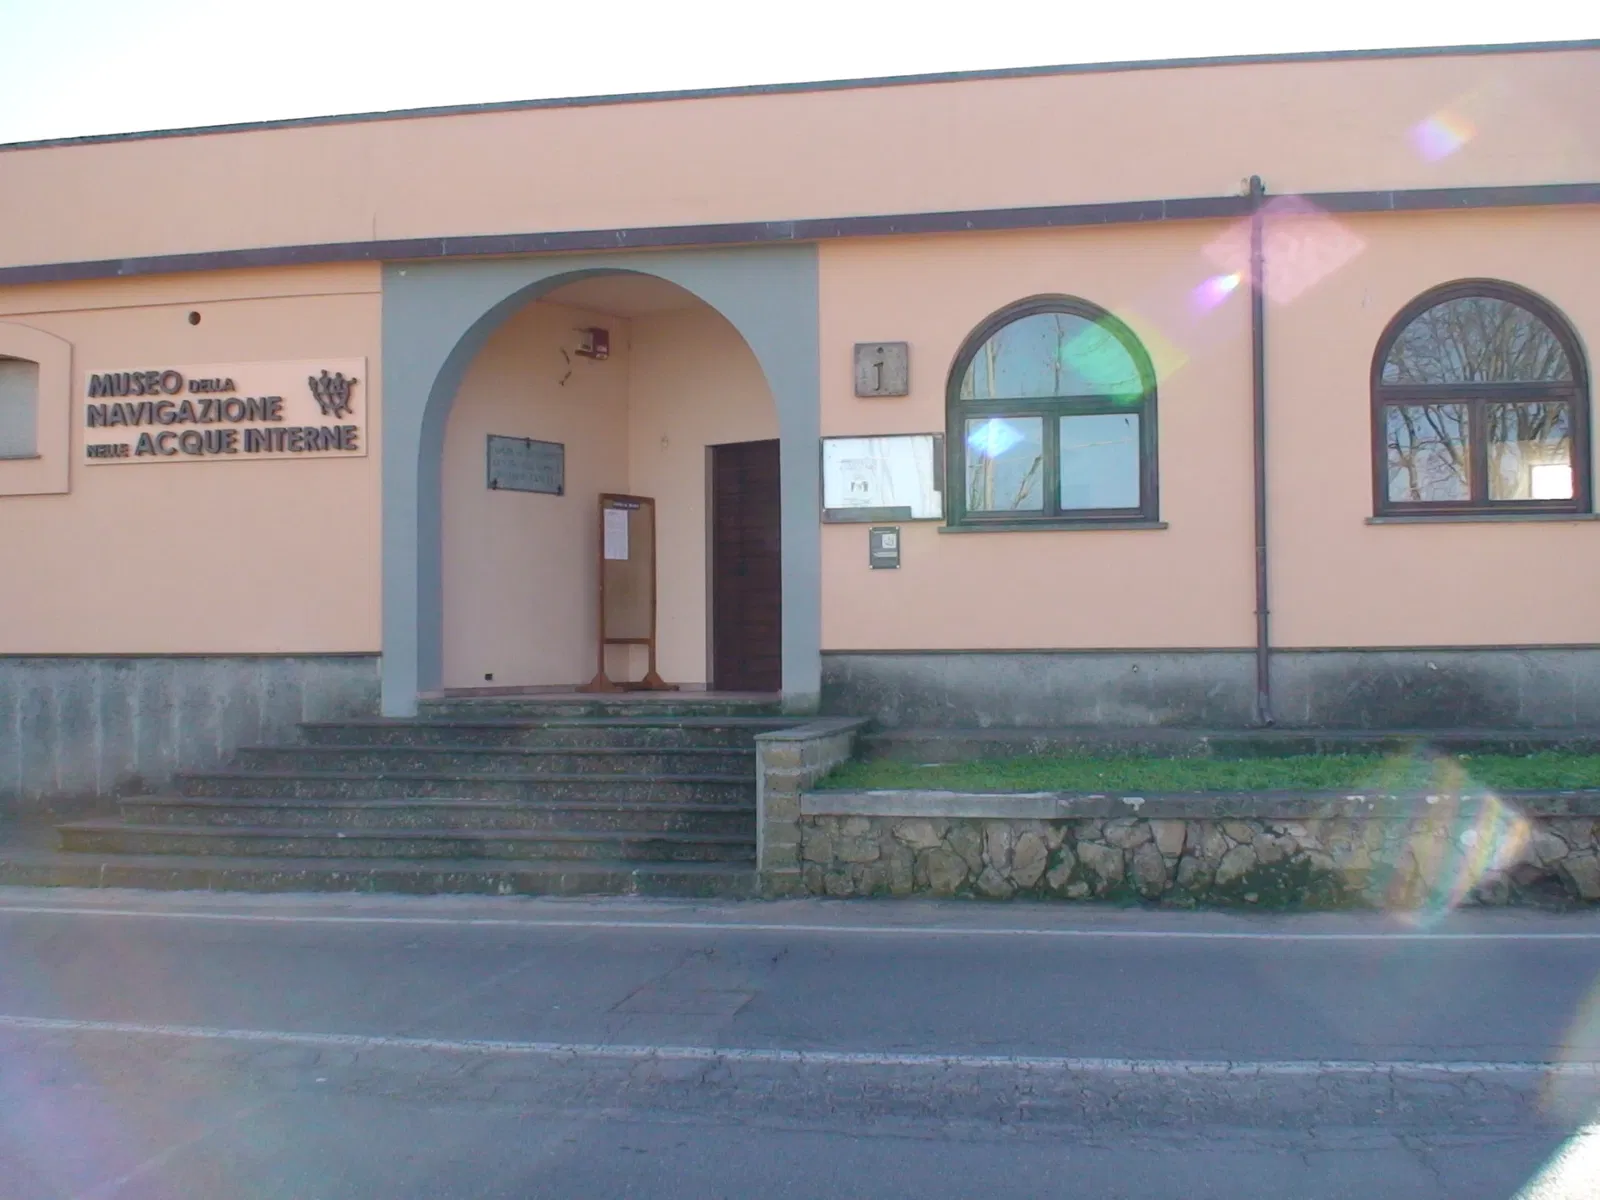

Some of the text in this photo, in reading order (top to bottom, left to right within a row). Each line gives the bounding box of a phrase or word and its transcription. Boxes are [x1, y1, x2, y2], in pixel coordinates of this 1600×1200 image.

[88, 370, 236, 398] MUSEO DELLA
[87, 396, 283, 428] NAVIGAZIONE
[87, 425, 358, 458] NELLE ACQUE INTERNE
